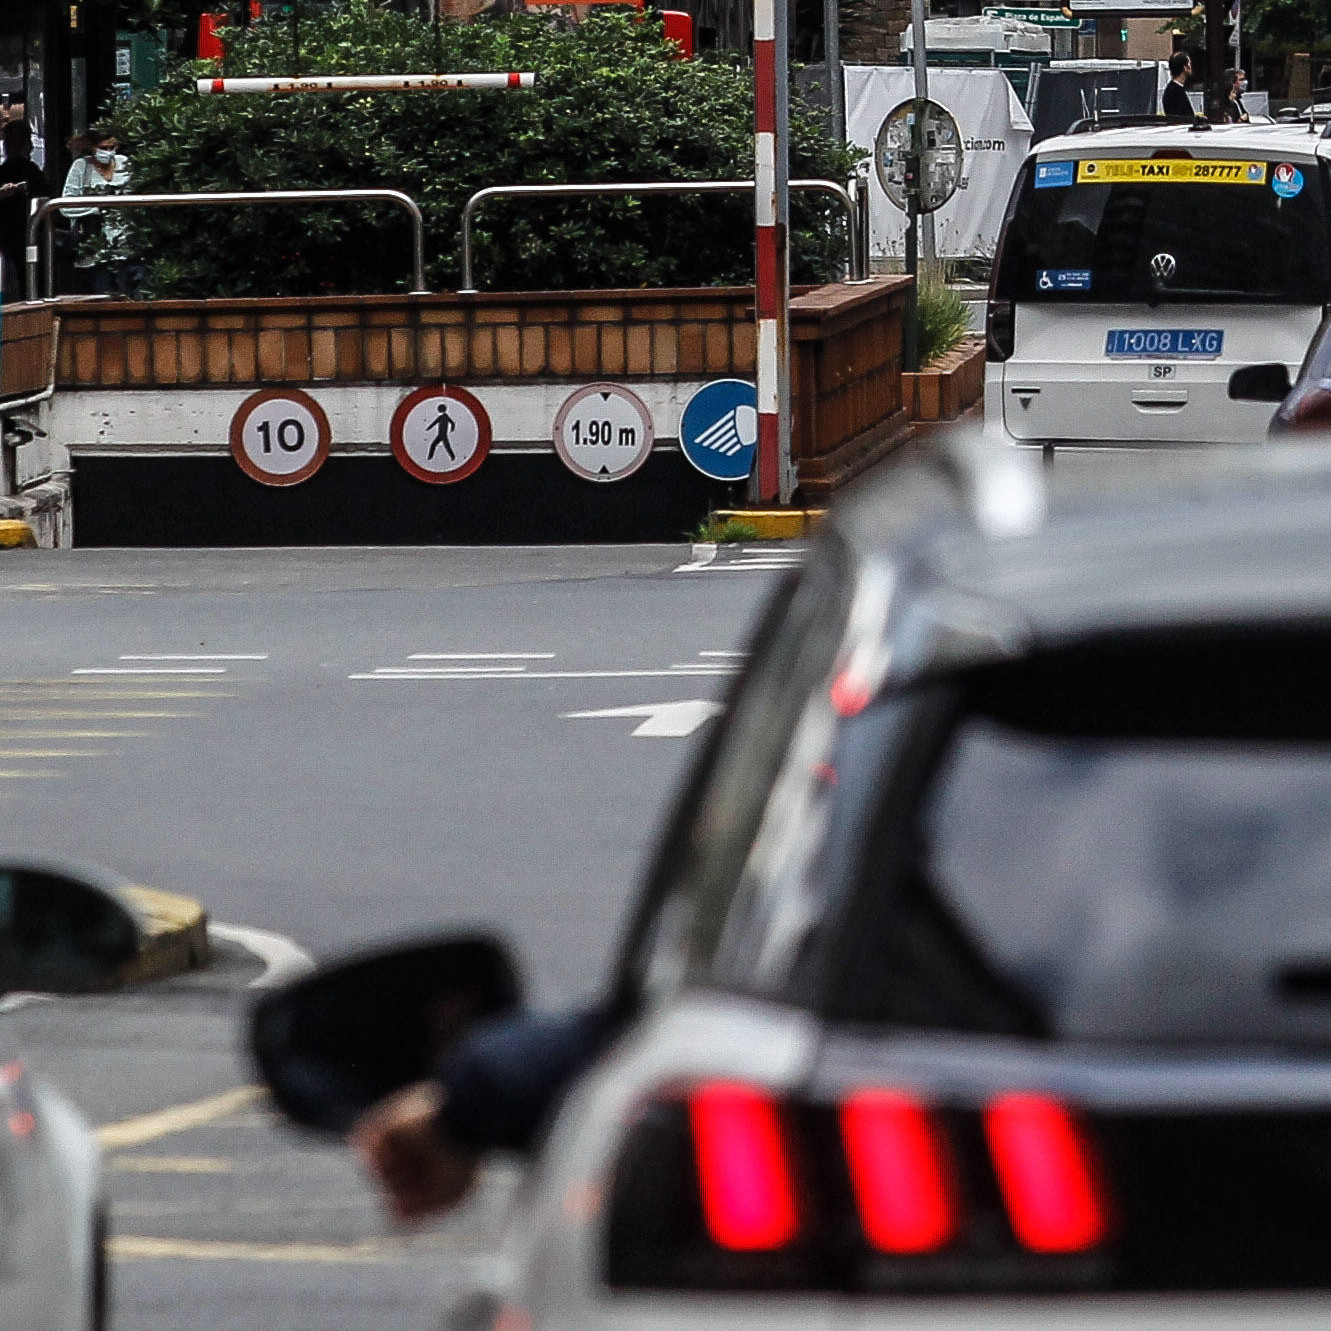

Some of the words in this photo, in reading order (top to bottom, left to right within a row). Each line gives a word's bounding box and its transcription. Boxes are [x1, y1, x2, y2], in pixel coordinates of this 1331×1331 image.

[1193, 164, 1242, 178] 287777
[1122, 332, 1172, 351] 1008
[1178, 332, 1218, 352] LXG
[1153, 366, 1172, 378] SP
[256, 419, 305, 455] 10
[571, 420, 613, 448] 1.90
[618, 429, 636, 448] m
